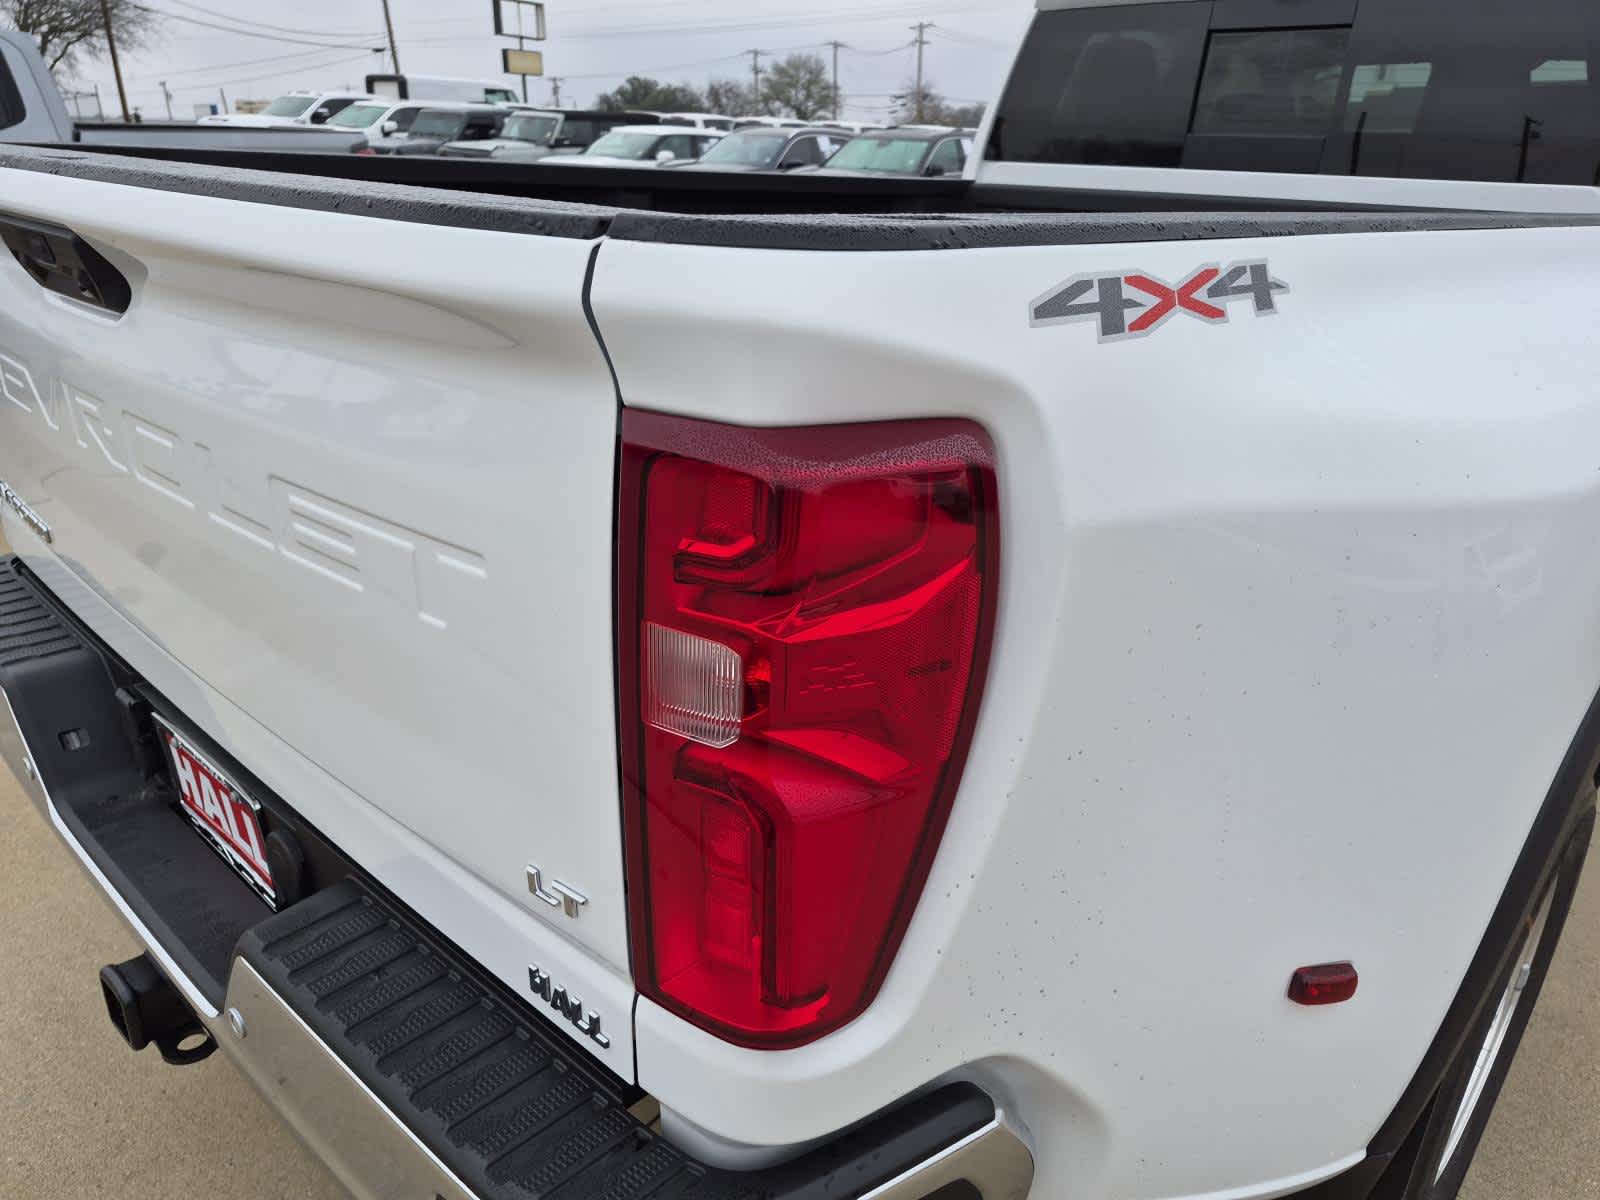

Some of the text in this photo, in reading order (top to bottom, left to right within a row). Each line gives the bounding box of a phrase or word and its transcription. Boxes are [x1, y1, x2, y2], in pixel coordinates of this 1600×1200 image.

[169, 744, 270, 876] HALL
[526, 864, 588, 919] LT
[528, 963, 611, 1050] HALL
